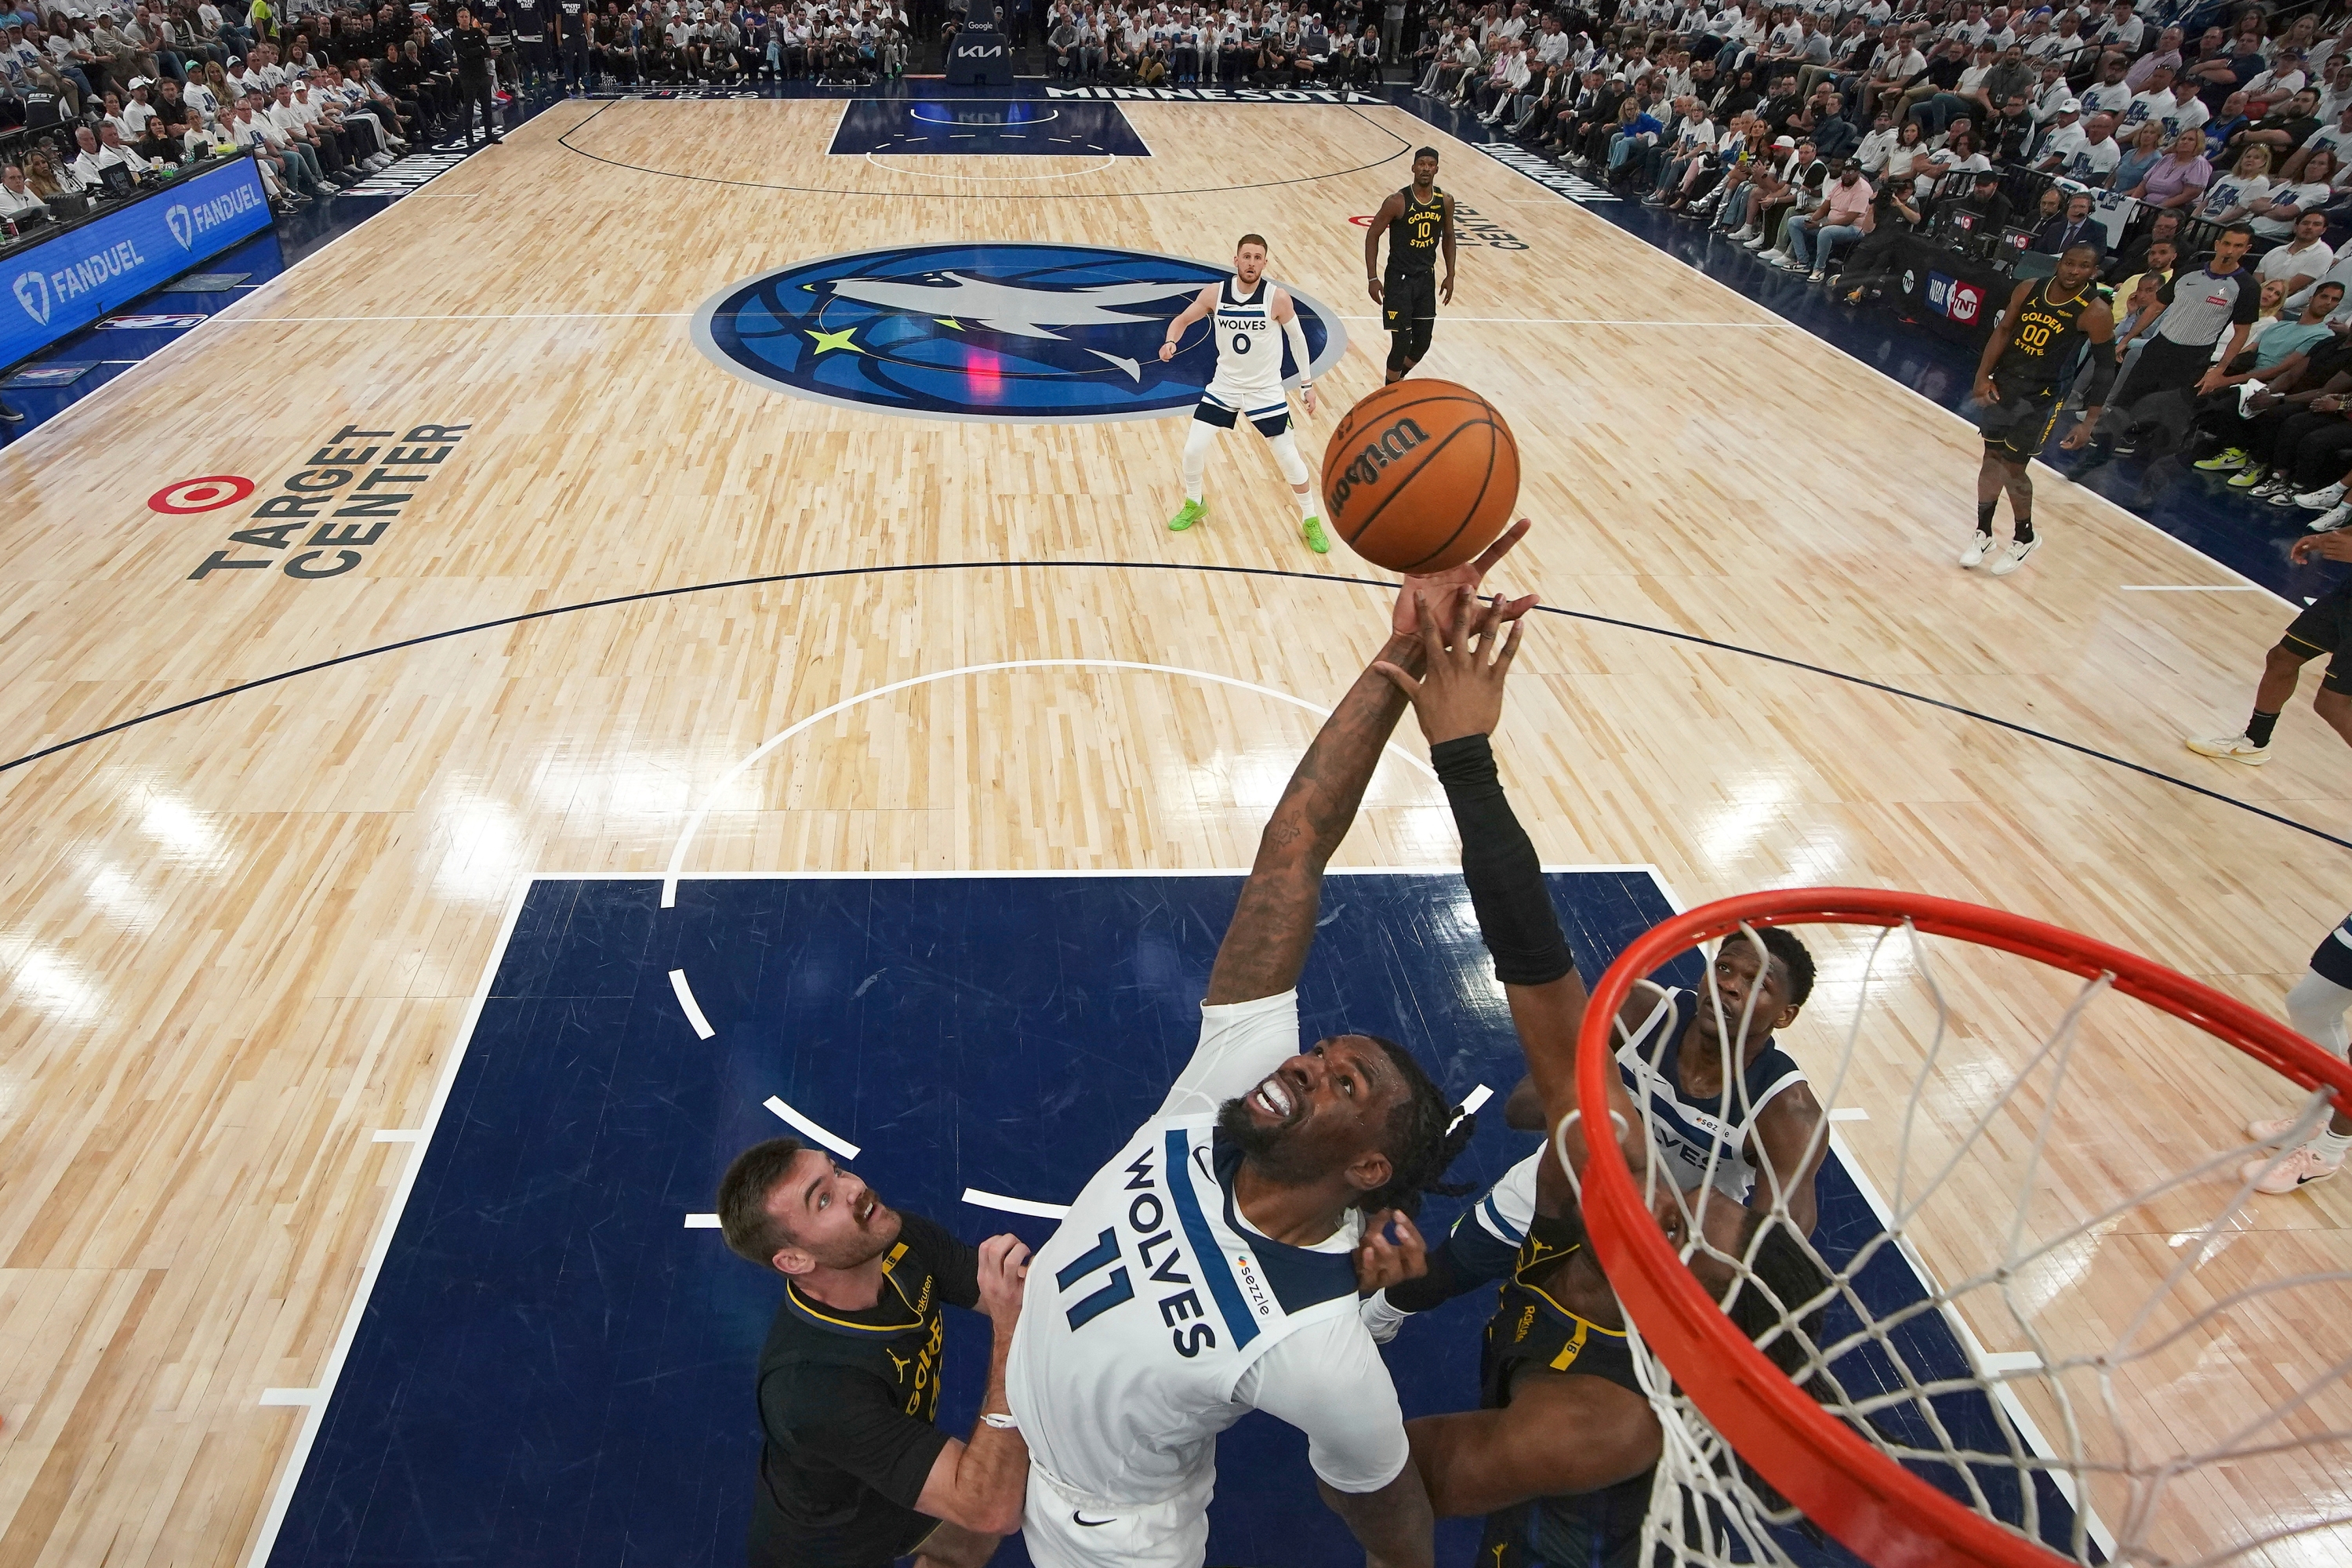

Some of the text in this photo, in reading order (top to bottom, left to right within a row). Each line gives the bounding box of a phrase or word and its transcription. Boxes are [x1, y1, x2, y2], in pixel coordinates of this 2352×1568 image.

[968, 21, 993, 31] Google
[958, 45, 1002, 57] KIA
[1045, 87, 1388, 103] MINNESOTA
[353, 153, 468, 188] PLAYOFFS
[1471, 142, 1624, 202] TIMBERWOLVES
[193, 183, 261, 233] FANDUEL
[1408, 212, 1441, 224] GOLDEN
[1410, 237, 1434, 248] STATE
[1418, 222, 1431, 238] 10
[51, 240, 144, 303] FANDUEL
[1929, 278, 1947, 305] NBA
[1218, 318, 1266, 330] WOLVES
[2021, 312, 2065, 334] GOLDEN
[2023, 325, 2050, 347] 00
[1232, 333, 1251, 354] 0
[2014, 338, 2045, 356] STATE
[1328, 417, 1432, 518] Wilson
[187, 424, 396, 580] TARGET
[283, 423, 473, 579] CENTER
[1700, 1118, 1730, 1138] sezle
[1123, 1145, 1216, 1358] WOLVES
[1055, 1225, 1135, 1333] 11
[1241, 1266, 1269, 1316] sezzle
[916, 1275, 933, 1314] akuten
[906, 1310, 943, 1416] GOLDE
